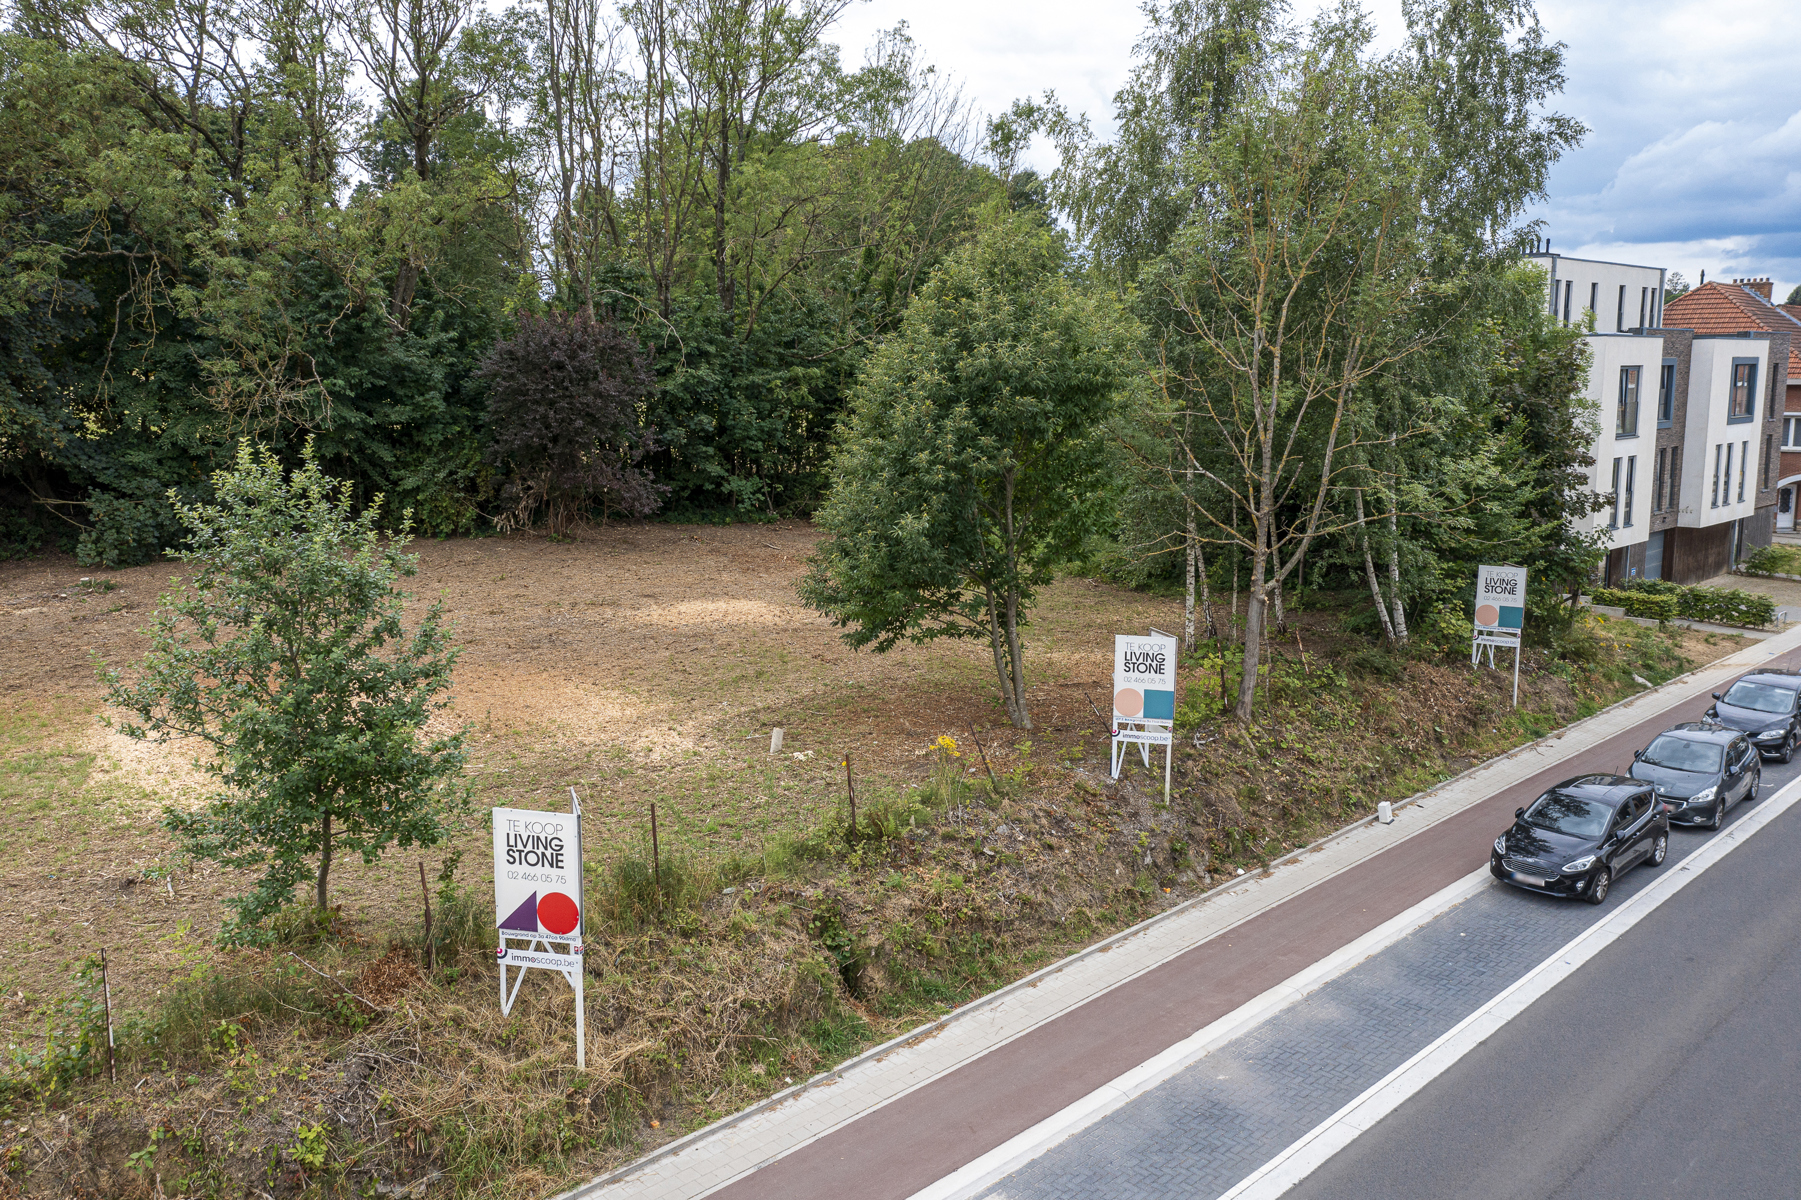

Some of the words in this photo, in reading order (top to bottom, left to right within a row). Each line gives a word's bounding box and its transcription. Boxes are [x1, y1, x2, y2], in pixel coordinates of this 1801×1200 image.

[1496, 571, 1518, 579] KOOP
[1485, 577, 1518, 587] LIVING
[1484, 585, 1517, 595] STONE
[1125, 642, 1135, 651] TE
[1138, 643, 1166, 652] KOOP
[1125, 651, 1166, 663] LIVING
[1123, 661, 1165, 675] STONE
[1123, 732, 1168, 742] immoscoop.be
[506, 819, 520, 833] TE
[524, 821, 564, 836] KOOP
[506, 832, 564, 852] LIVING
[506, 848, 564, 870] STONE
[507, 870, 519, 880] 02
[521, 872, 539, 882] 466
[540, 873, 553, 883] 05
[555, 874, 567, 884] 75
[501, 930, 529, 938] Bouwgrond
[511, 952, 575, 968] immoscoop.be
